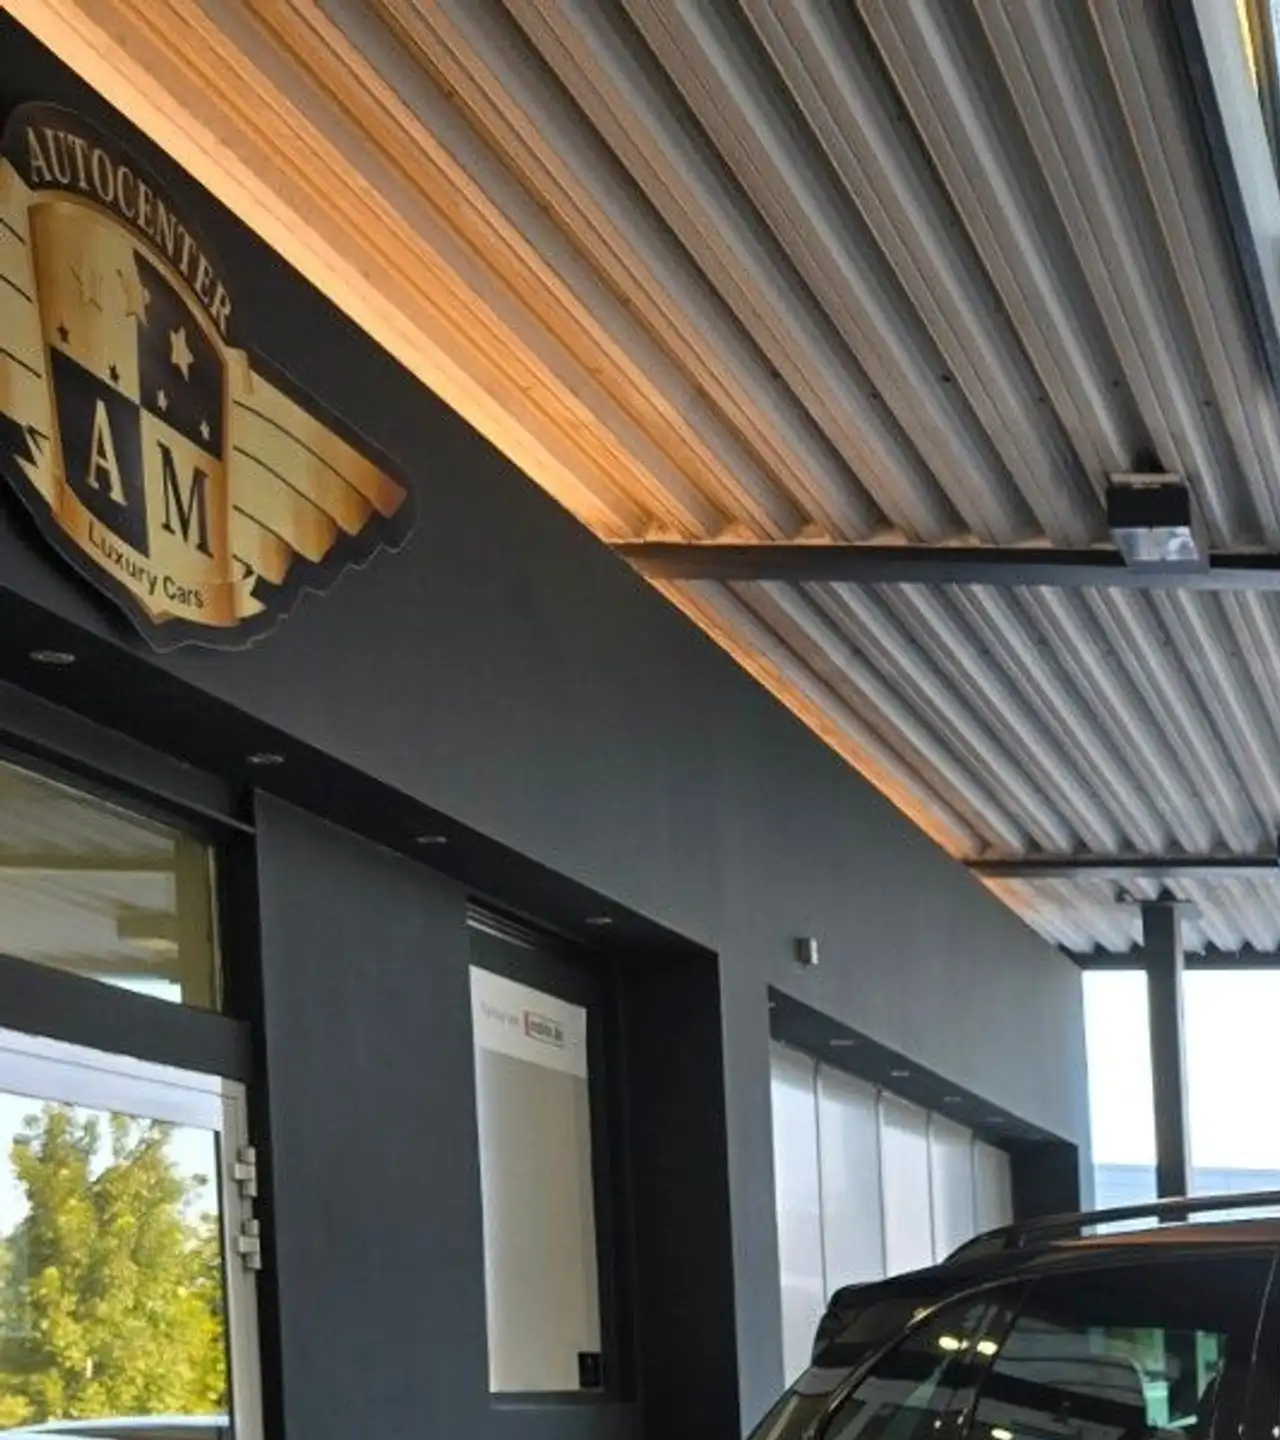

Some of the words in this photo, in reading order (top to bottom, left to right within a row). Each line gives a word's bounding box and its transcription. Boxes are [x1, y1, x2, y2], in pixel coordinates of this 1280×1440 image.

[26, 126, 232, 337] AUTOCENTER
[84, 396, 128, 507] A
[156, 438, 214, 559] M
[88, 519, 157, 596] Luxury
[162, 575, 204, 609] Cars
